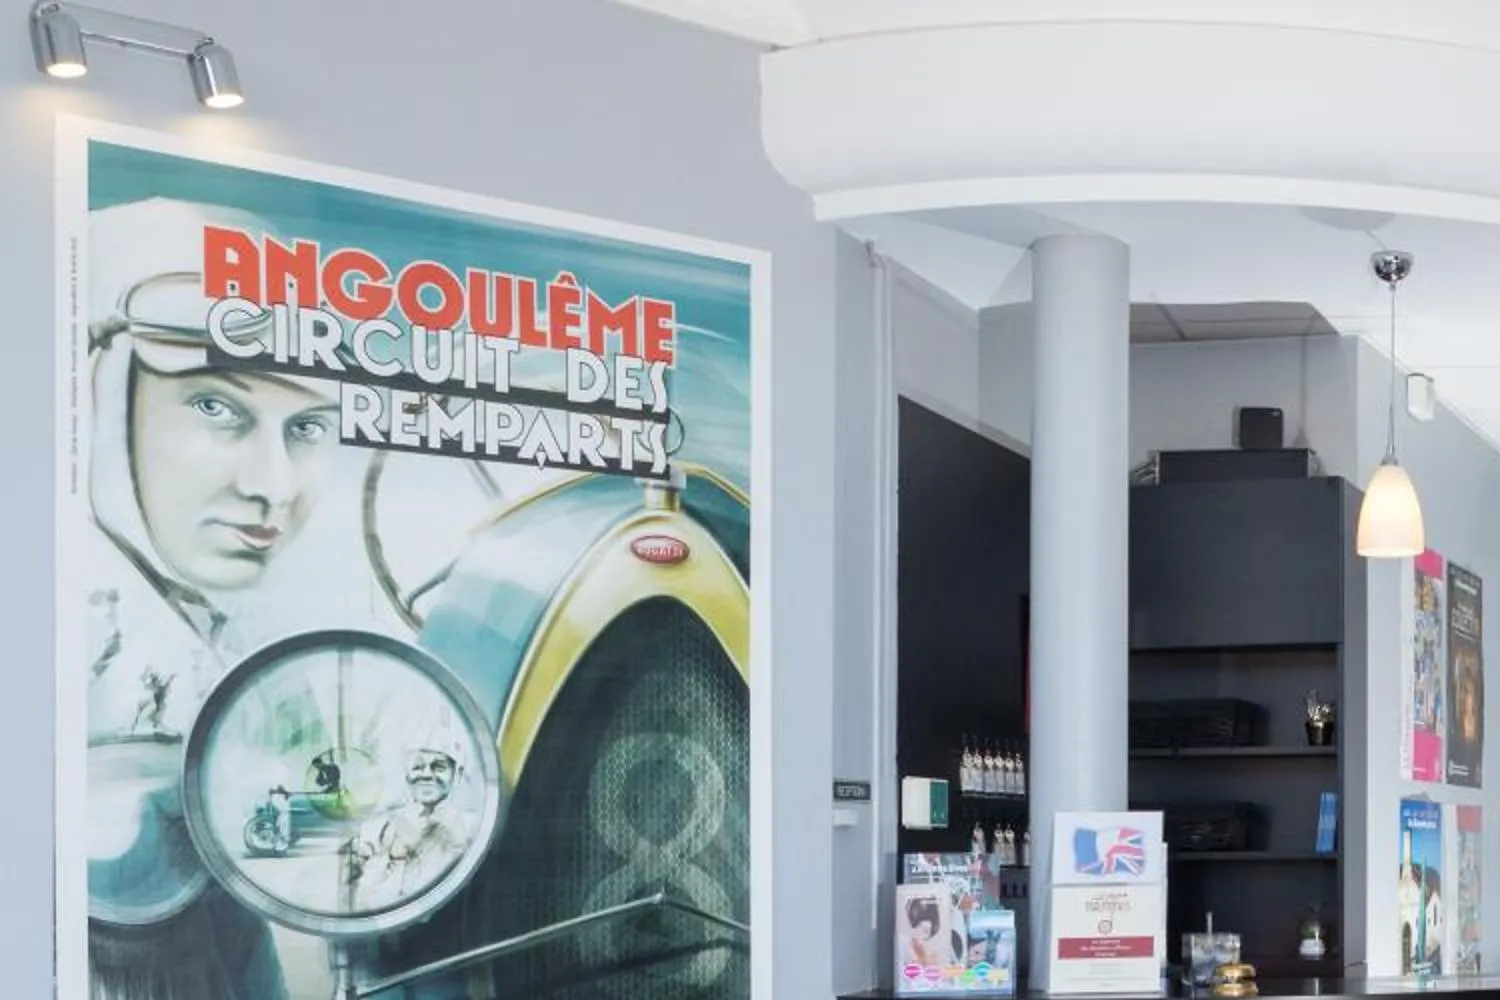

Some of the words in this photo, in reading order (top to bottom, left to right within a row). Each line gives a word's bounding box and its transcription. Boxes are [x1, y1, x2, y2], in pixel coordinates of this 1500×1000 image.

[204, 225, 676, 367] ANGOULÊME
[207, 297, 521, 394] CIRCUIT
[565, 347, 670, 414] DES
[341, 380, 670, 475] REMPARTS
